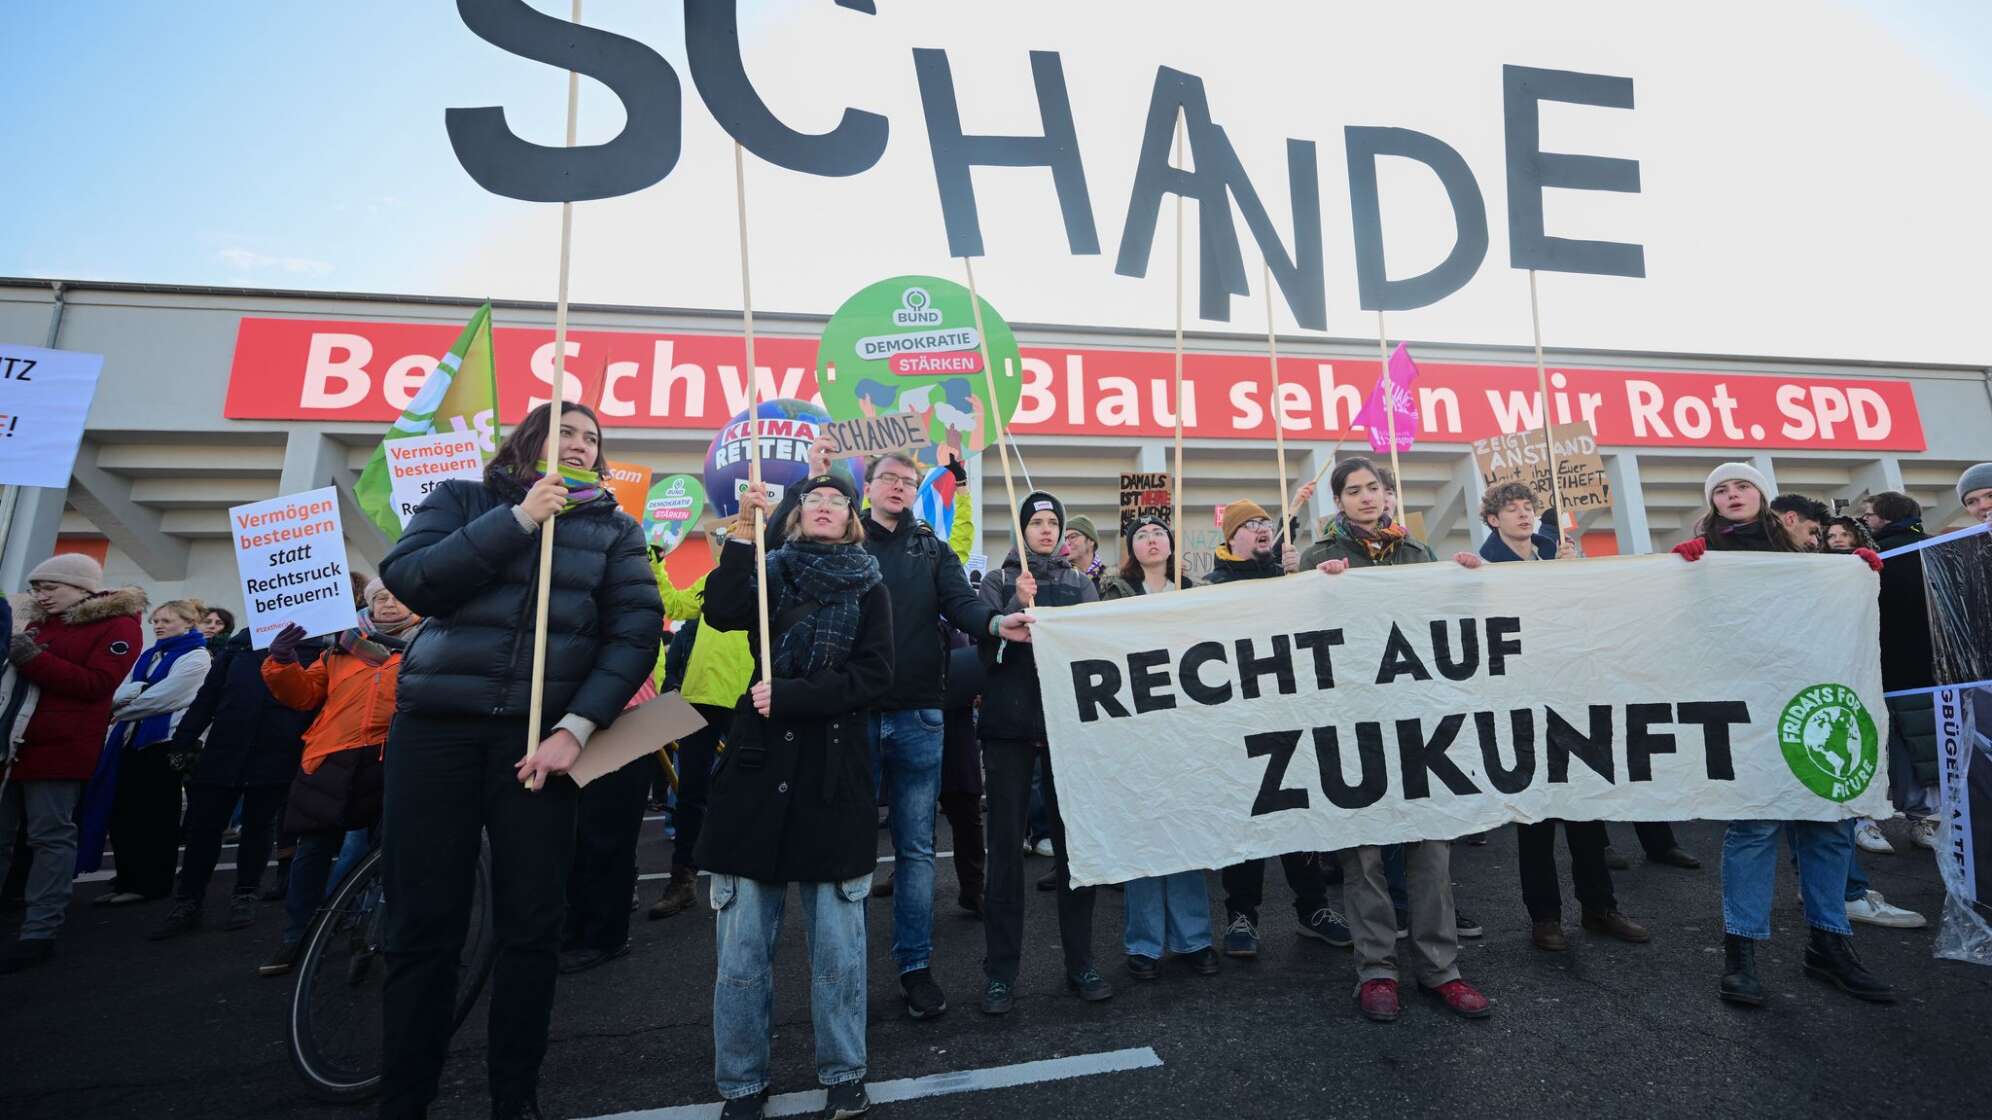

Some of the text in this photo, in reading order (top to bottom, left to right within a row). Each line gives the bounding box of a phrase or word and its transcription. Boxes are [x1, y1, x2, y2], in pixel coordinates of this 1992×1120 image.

[445, 0, 1646, 331] SCHANDE
[898, 312, 939, 323] BUND
[865, 333, 971, 354] DEMOKRATIE
[0, 356, 37, 381] TZ
[899, 355, 974, 372] STÄRKEN
[300, 332, 440, 411] Be
[1229, 364, 1463, 433] sehn
[1487, 373, 1602, 437] wir
[1626, 379, 1767, 441] Rot.
[1776, 383, 1892, 441] SPD
[724, 420, 815, 442] KLIMA
[827, 415, 925, 454] SCHANDE
[1473, 431, 1532, 455] ZEIGT
[390, 441, 475, 461] Vermögen
[716, 438, 810, 471] RETTEN
[1490, 436, 1596, 471] ANSTAND
[394, 458, 477, 478] besteuern
[1558, 460, 1587, 474] Euer
[1121, 474, 1167, 490] DAMALS
[1529, 470, 1606, 492] ARTEIHEFT
[237, 500, 333, 529] Vermögen
[240, 520, 335, 550] besteuern
[269, 544, 312, 567] statt
[247, 562, 342, 595] Rechtsruck
[255, 582, 340, 613] befeuern!
[1070, 616, 1522, 723] RECHT AUF
[1782, 687, 1861, 743] FRIDAYS FOR
[1243, 700, 1751, 817] ZUKUNFT
